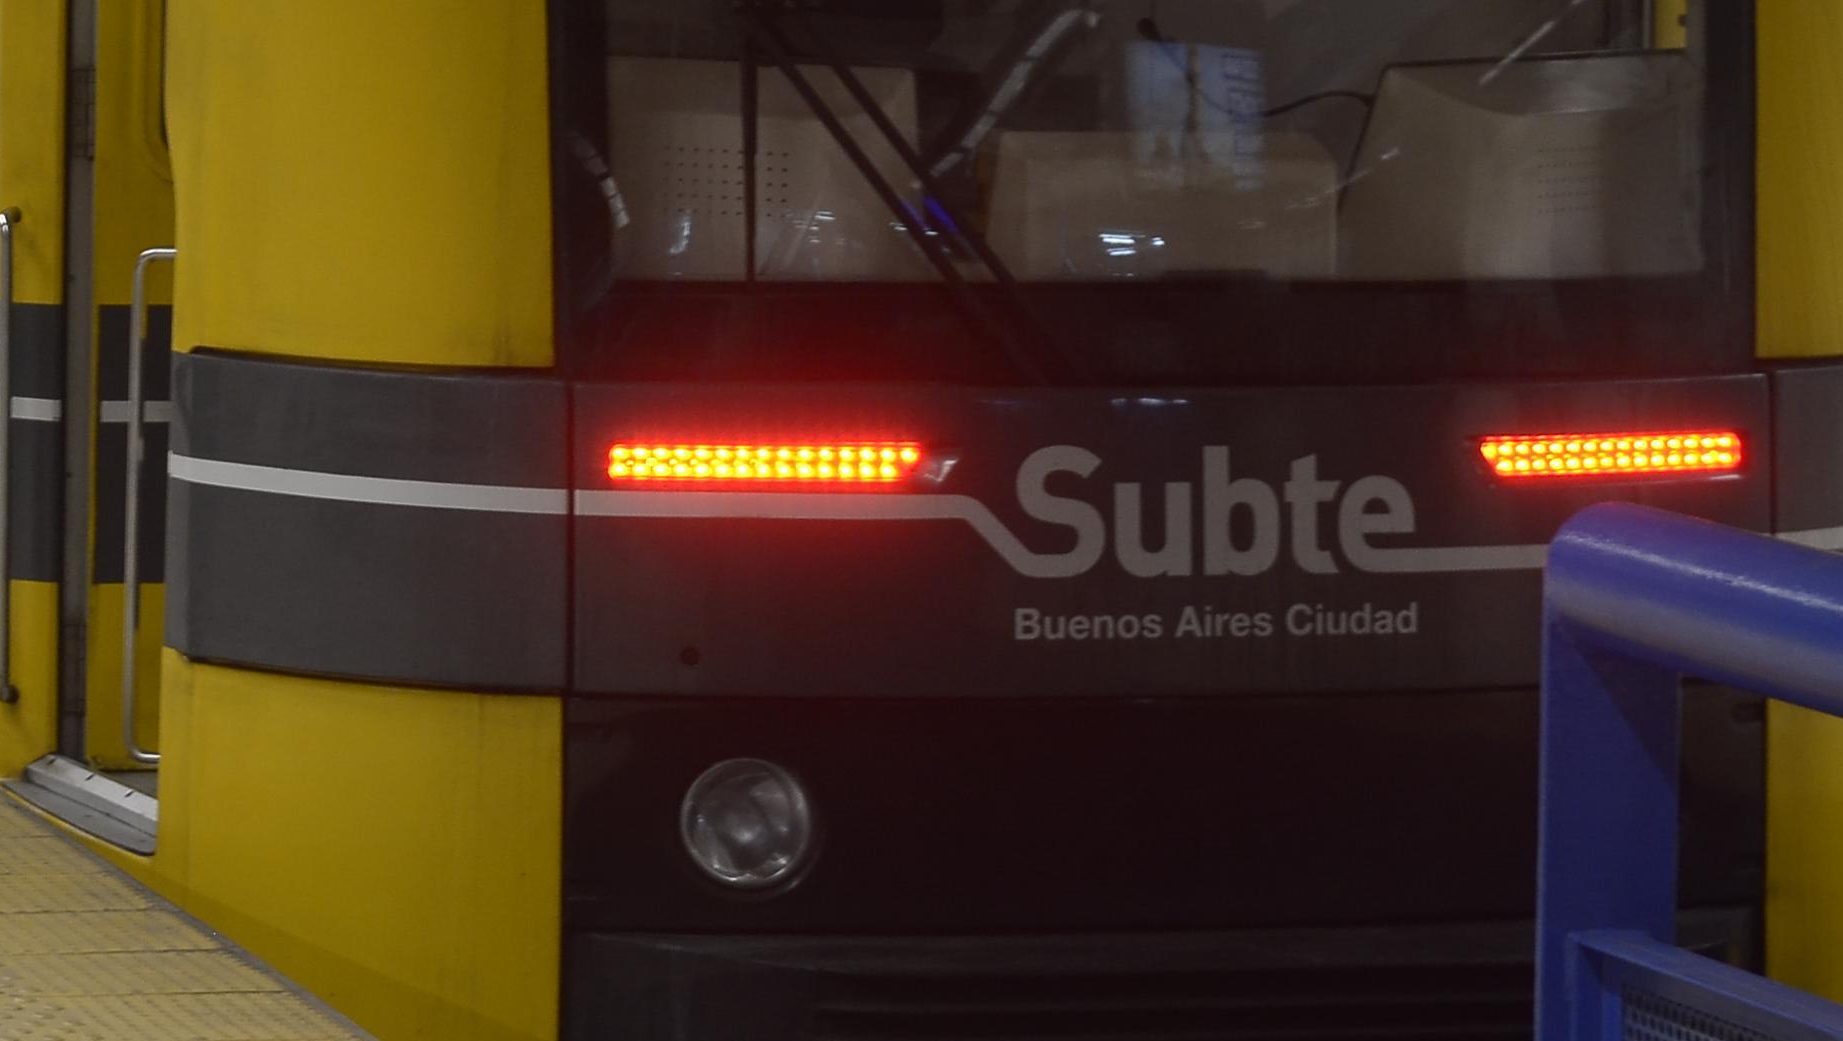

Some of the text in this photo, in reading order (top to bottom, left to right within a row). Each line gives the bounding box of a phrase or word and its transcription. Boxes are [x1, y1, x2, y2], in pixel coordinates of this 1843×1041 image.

[1015, 444, 1416, 578] Subte
[1014, 601, 1420, 640] Buenos Aires Ciudad
